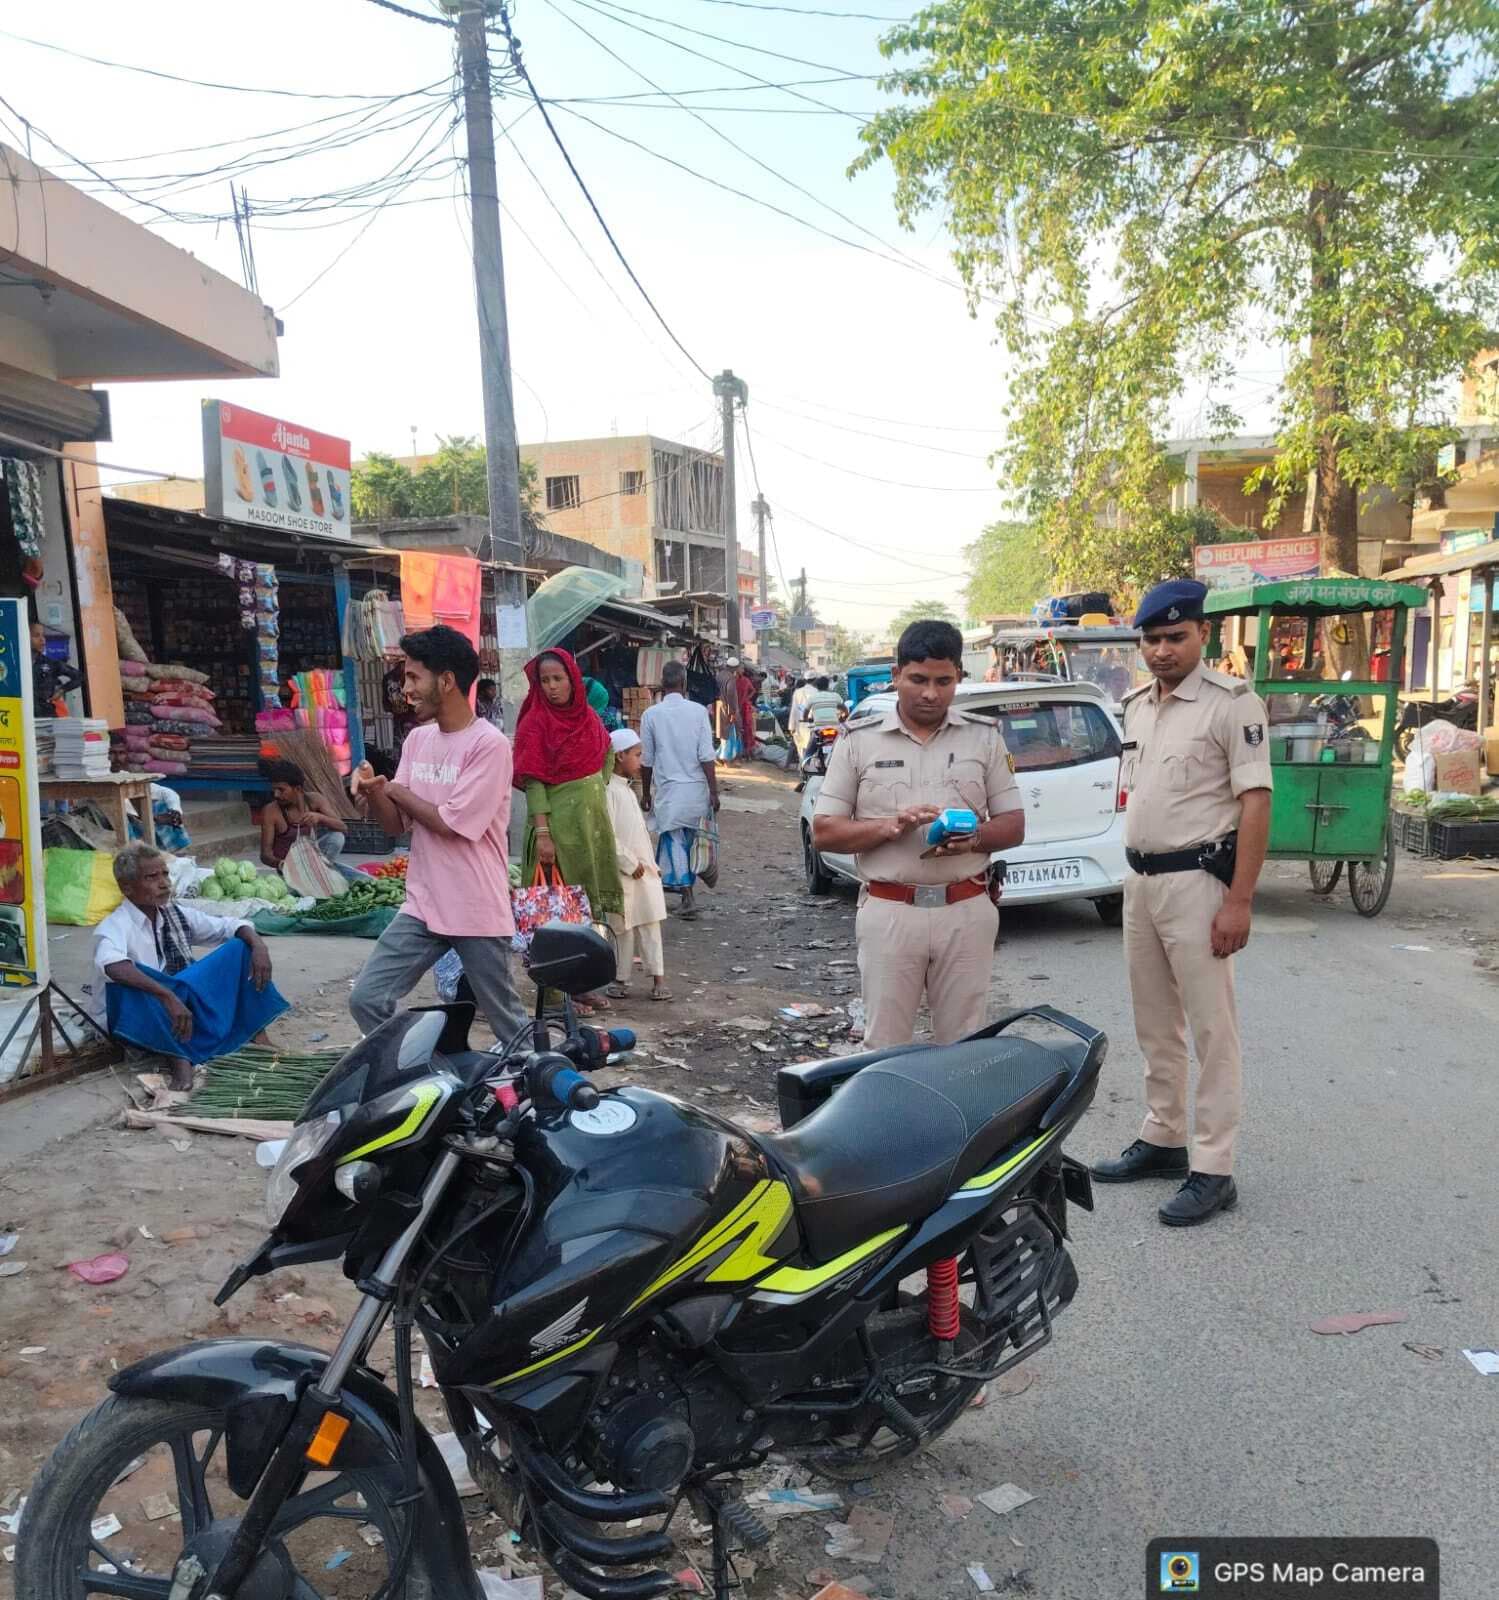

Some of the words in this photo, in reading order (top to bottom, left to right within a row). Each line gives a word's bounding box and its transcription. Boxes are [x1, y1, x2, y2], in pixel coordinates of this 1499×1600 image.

[272, 422, 311, 450] Ajanta
[247, 507, 286, 526] MASOOM
[287, 514, 309, 529] SHOE
[309, 519, 333, 534] STORE
[1215, 544, 1264, 562] HELPLINE
[1267, 541, 1316, 558] AGENCIES
